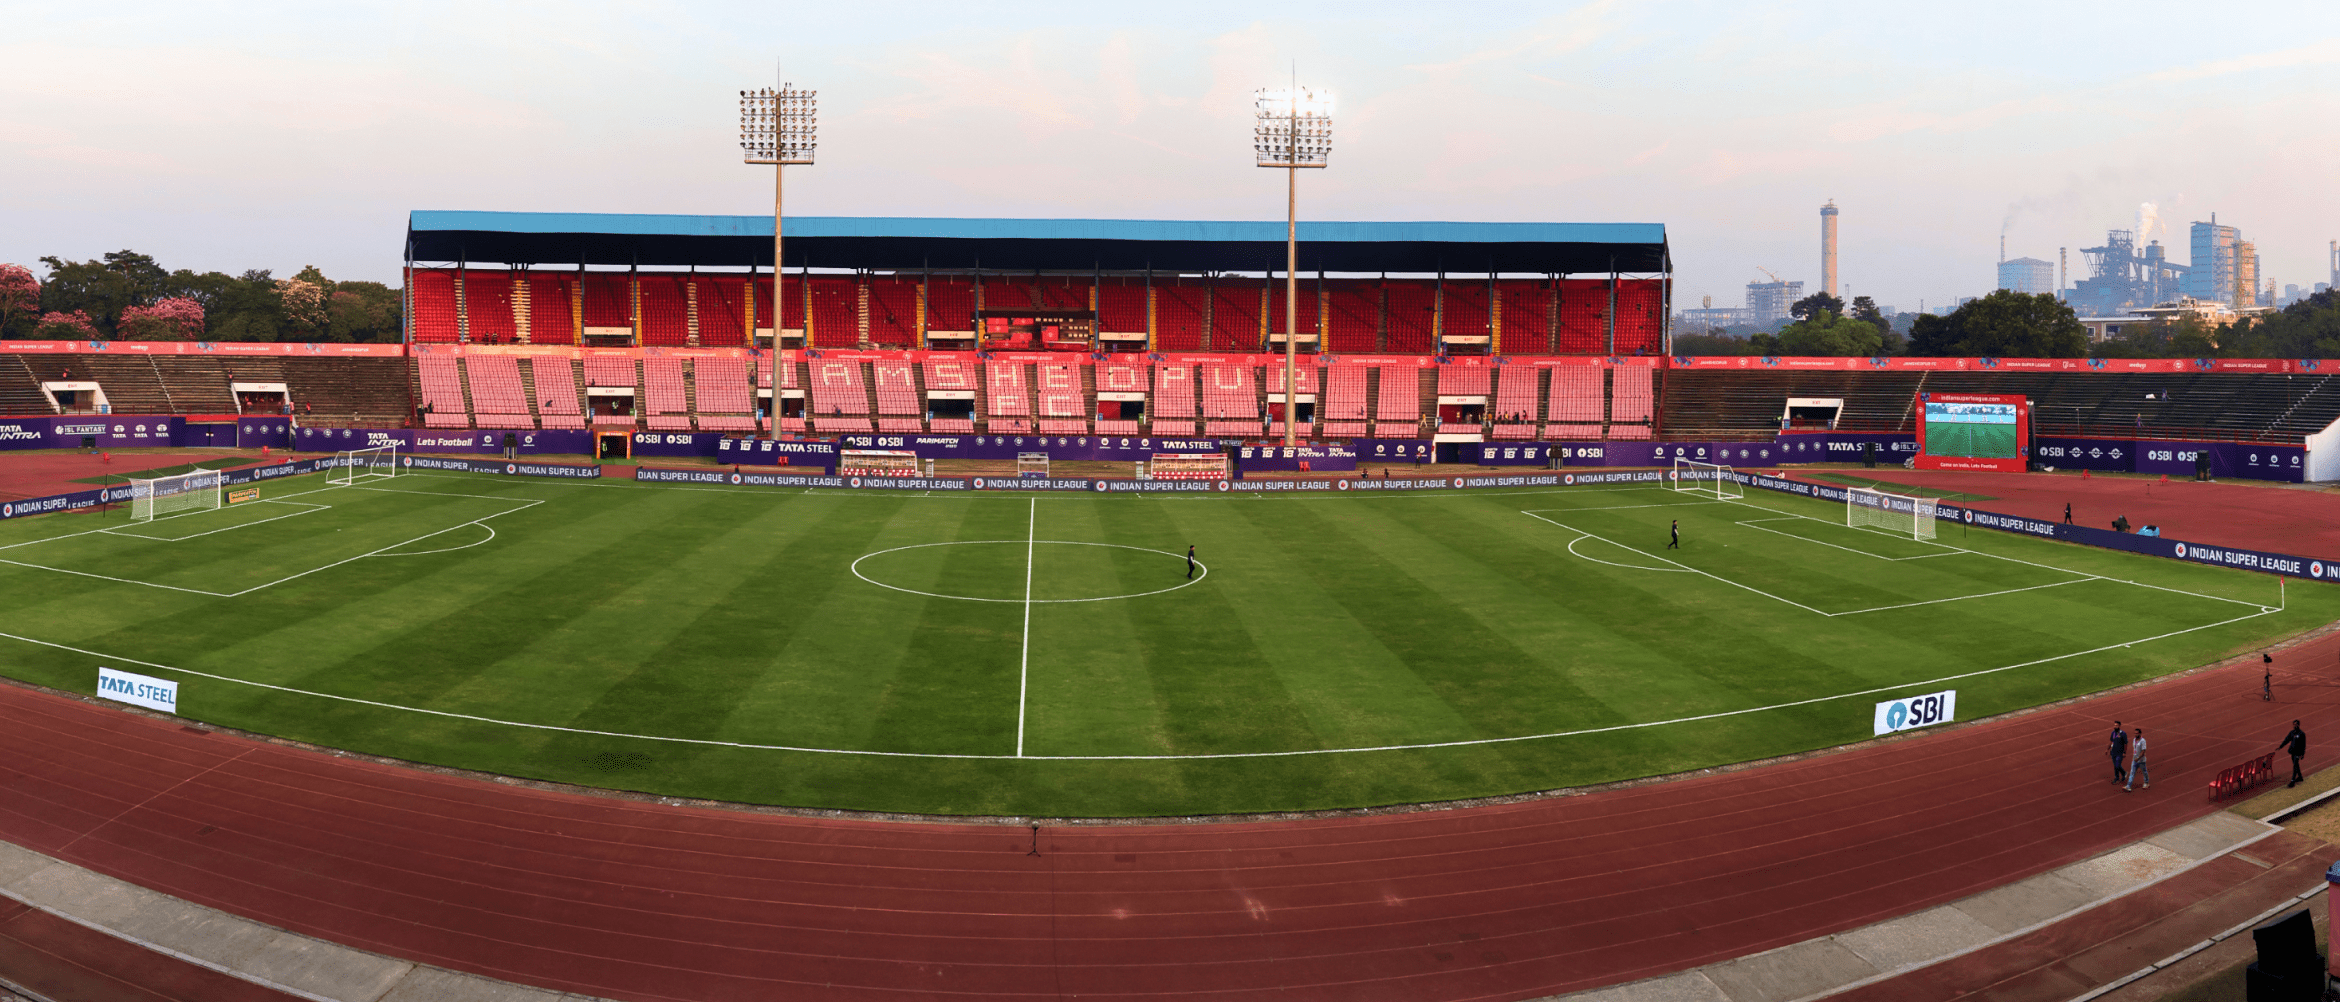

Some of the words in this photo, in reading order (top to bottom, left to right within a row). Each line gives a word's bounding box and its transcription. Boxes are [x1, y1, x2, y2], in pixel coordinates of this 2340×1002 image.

[417, 438, 435, 446] Lets
[438, 438, 473, 446] Football
[645, 435, 661, 444] SBI
[675, 435, 692, 444] SBI
[856, 437, 872, 446] SBI
[887, 437, 903, 446] SBI
[916, 437, 960, 445] PARIMATCH
[778, 443, 805, 453] TATA
[807, 444, 834, 453] STEEL
[1162, 441, 1188, 449] TATA
[1189, 441, 1214, 450] STEEL
[1827, 442, 1855, 451] TATA
[1587, 448, 1603, 457] SBI
[2049, 447, 2064, 457] SBI
[2157, 450, 2172, 461] SBI
[415, 458, 441, 469] INDIAN
[442, 460, 469, 471] SUPER
[262, 468, 279, 479] INDIAN
[279, 465, 294, 477] SUPER
[519, 465, 547, 476] INDIAN
[548, 466, 575, 478] SUPER
[660, 472, 689, 481] SUPER
[690, 473, 724, 482] LEAGUE
[1577, 473, 1604, 483] INDIAN
[1606, 473, 1631, 482] SUPER
[1633, 471, 1662, 481] LEAGUE
[1681, 470, 1709, 479] INDIAN
[744, 475, 776, 485] INDIAN
[777, 476, 806, 486] SUPER
[809, 477, 842, 487] LEAGUE
[864, 478, 896, 488] INDIAN
[897, 478, 927, 489] SUPER
[930, 479, 965, 489] LEAGUE
[987, 478, 1019, 488] INDIAN
[1021, 480, 1049, 489] SUPER
[1053, 480, 1088, 489] LEAGUE
[1110, 481, 1142, 490] INDIAN
[1144, 481, 1174, 490] SUPER
[1176, 481, 1211, 491] LEAGUE
[1232, 481, 1263, 490] INDIAN
[1265, 481, 1295, 490] SUPER
[1297, 481, 1331, 490] LEAGUE
[1351, 480, 1381, 490] INDIAN
[1383, 480, 1411, 489] SUPER
[1413, 479, 1447, 488] LEAGUE
[1467, 477, 1496, 487] INDIAN
[1497, 476, 1524, 486] SUPER
[1526, 475, 1558, 485] LEAGUE
[1758, 476, 1774, 488] INDIAN
[1774, 478, 1790, 491] SUPER
[1790, 481, 1808, 494] LEAGUE
[111, 488, 132, 501] INDIAN
[1819, 488, 1839, 499] INDIAN
[1856, 493, 1878, 505] LEAGUE
[15, 500, 41, 515] INDIAN
[42, 498, 67, 511] SUPER
[1891, 499, 1912, 512] INDIAN
[1934, 507, 1959, 520] LEAGUE
[1975, 513, 1999, 527] INDIAN
[2000, 516, 2024, 532] SUPER
[2026, 520, 2055, 536] LEAGUE
[2190, 546, 2223, 562] INDIAN
[2225, 551, 2258, 568] SUPER
[2260, 556, 2301, 574] LEAGUE
[2327, 564, 2340, 579] IN
[100, 675, 135, 696] TATA
[138, 683, 175, 704] STEEL
[1909, 694, 1945, 726] SBI
